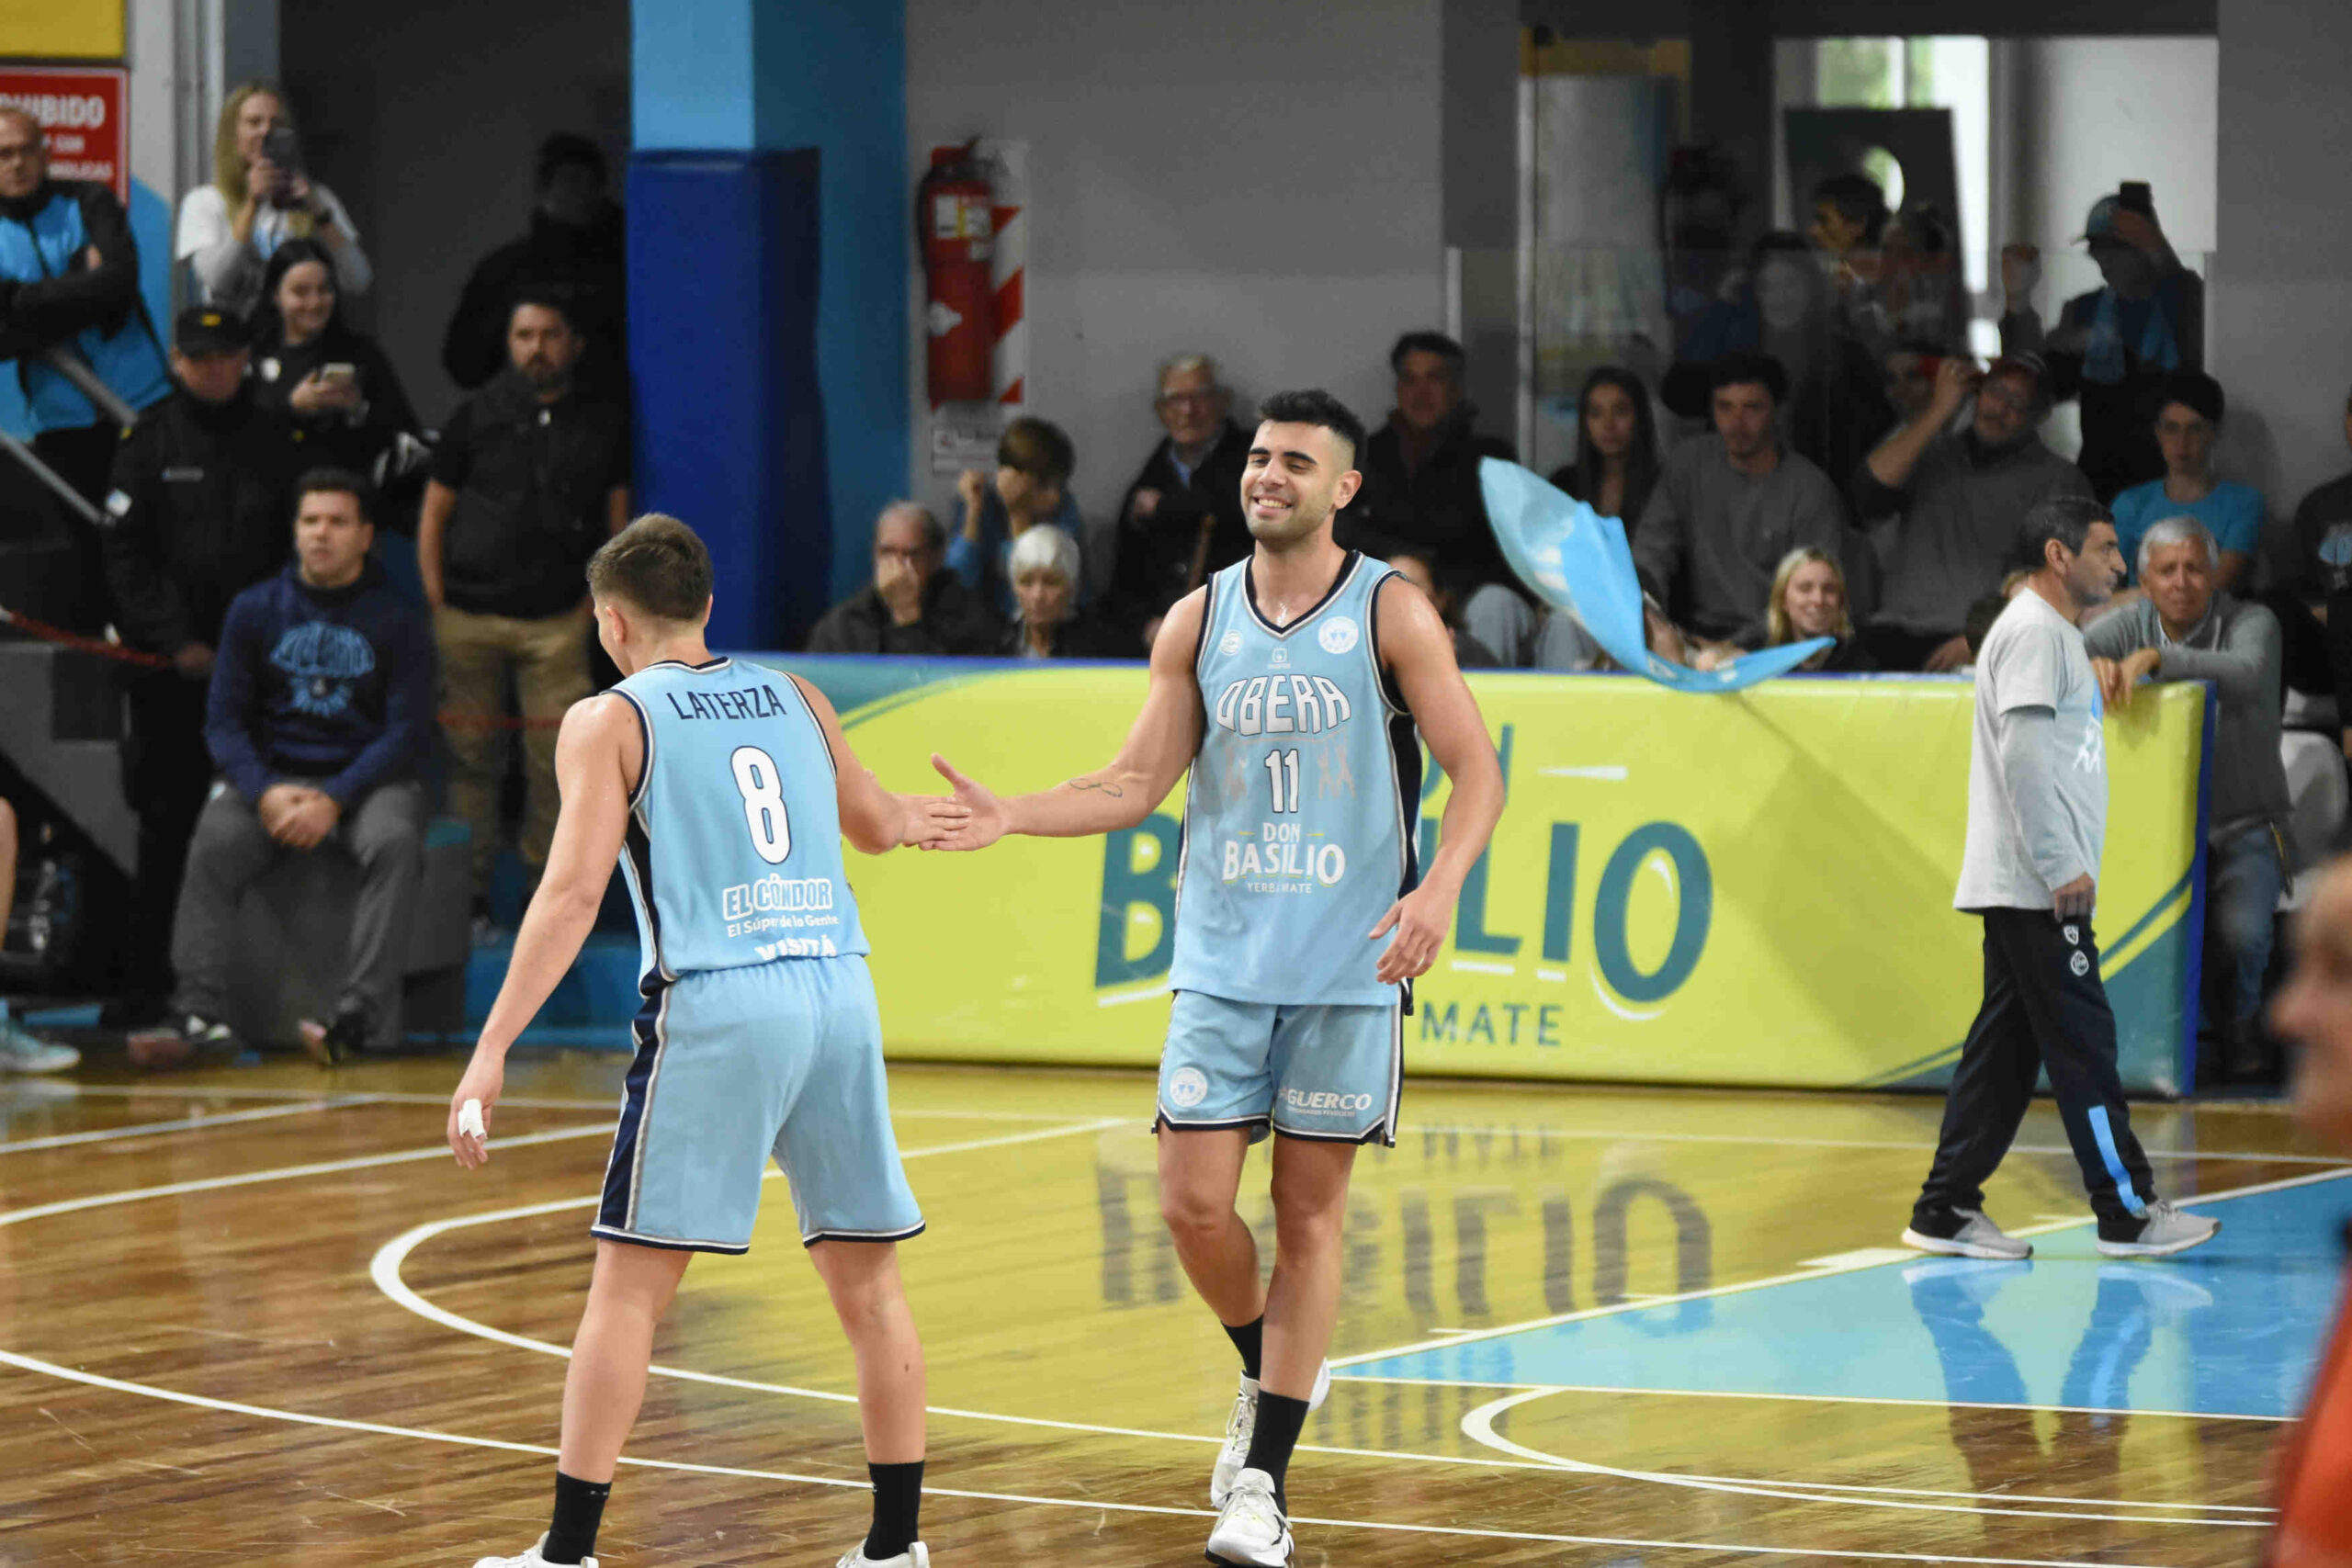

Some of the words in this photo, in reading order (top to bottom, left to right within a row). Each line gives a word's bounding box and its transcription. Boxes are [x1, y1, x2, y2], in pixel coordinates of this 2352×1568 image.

[666, 684, 787, 720] LATERZA
[1216, 674, 1351, 737] OBERA
[1264, 749, 1299, 813] 11
[729, 745, 792, 865] 8
[1262, 822, 1301, 842] DON
[1222, 840, 1346, 884] BASILIO
[722, 884, 753, 920] EL
[752, 872, 833, 911] CÓNDOR
[1095, 811, 1713, 1003] BLIO
[727, 922, 741, 938] El
[779, 914, 792, 928] de
[792, 914, 804, 928] la
[805, 914, 839, 928] Gente
[1420, 1000, 1563, 1047] MATE
